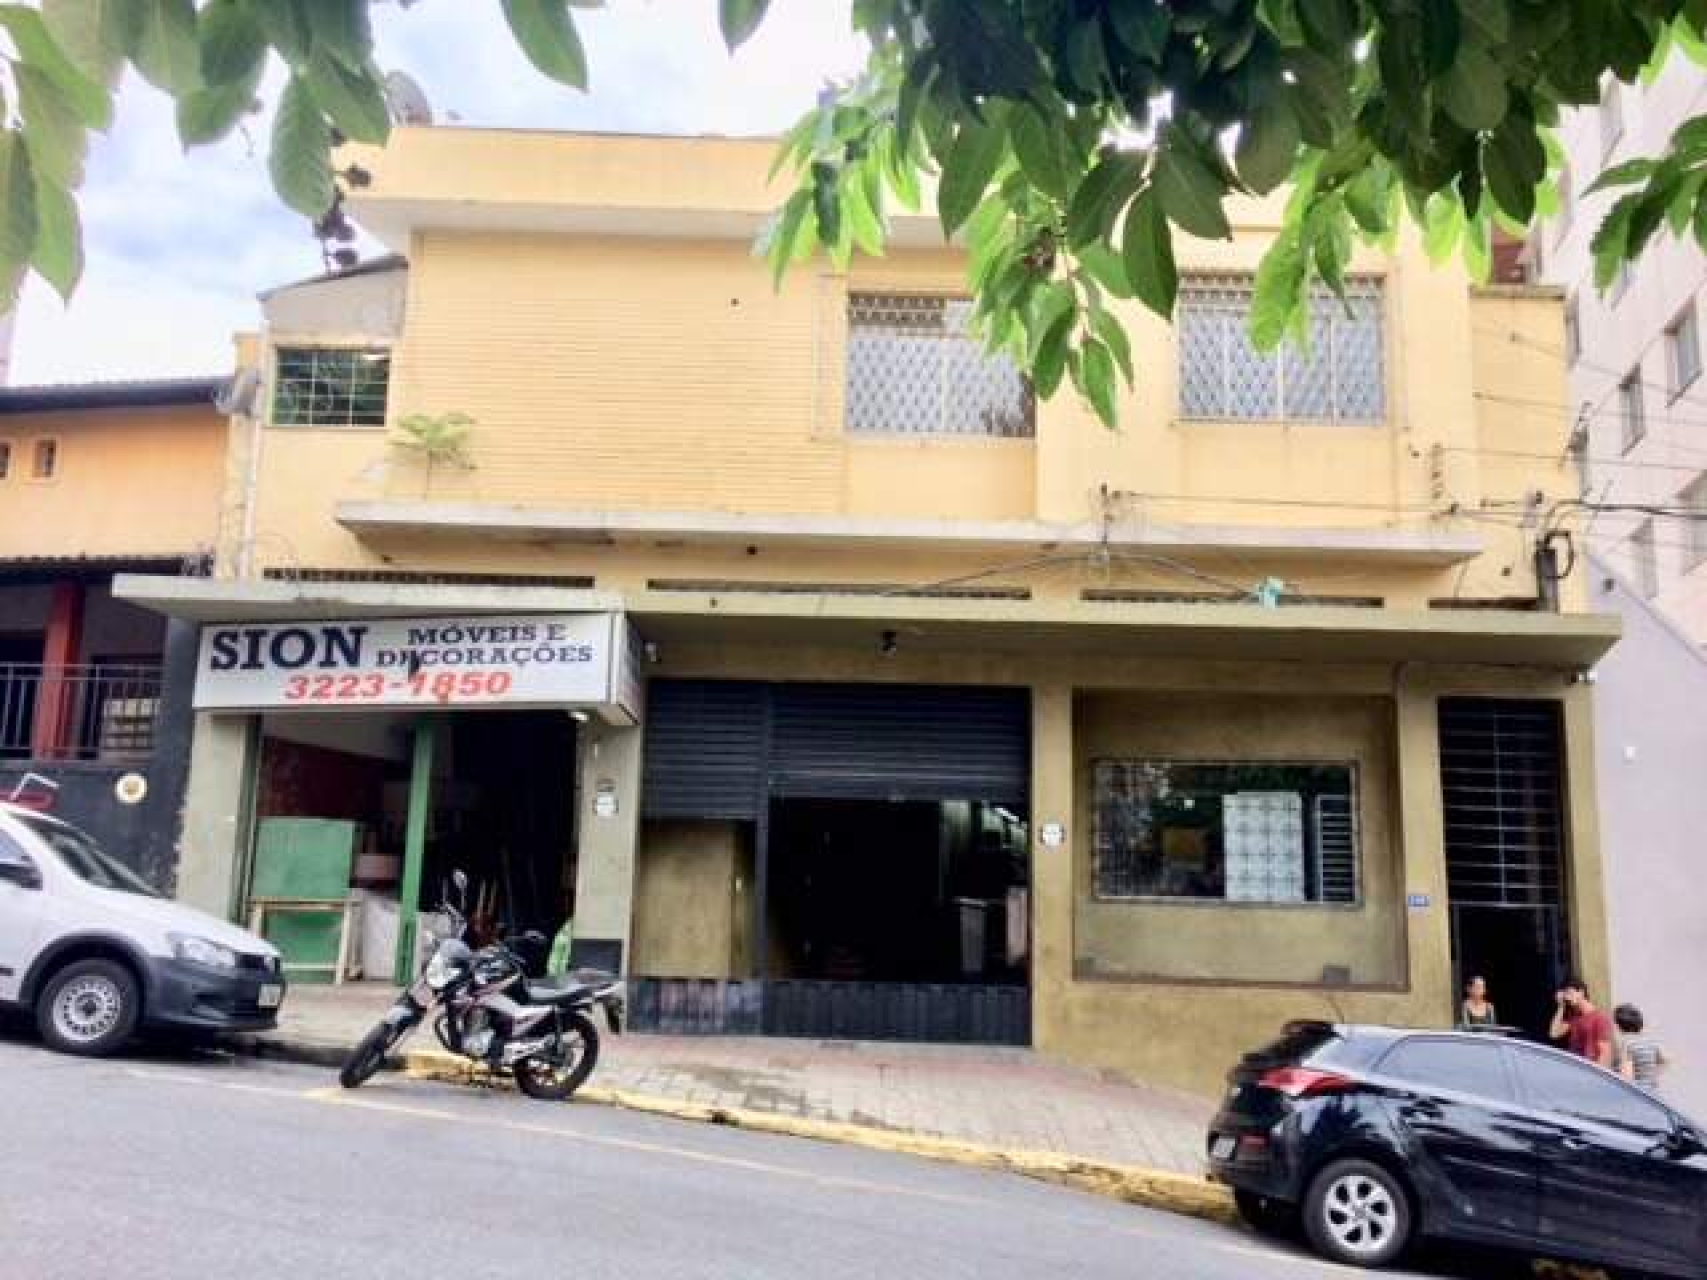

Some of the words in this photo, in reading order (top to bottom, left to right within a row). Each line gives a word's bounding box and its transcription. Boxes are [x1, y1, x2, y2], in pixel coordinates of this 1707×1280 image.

[407, 622, 537, 645] MÓVEIS
[546, 623, 568, 641] E
[210, 626, 368, 671] SION
[284, 671, 513, 699] 3223-1850
